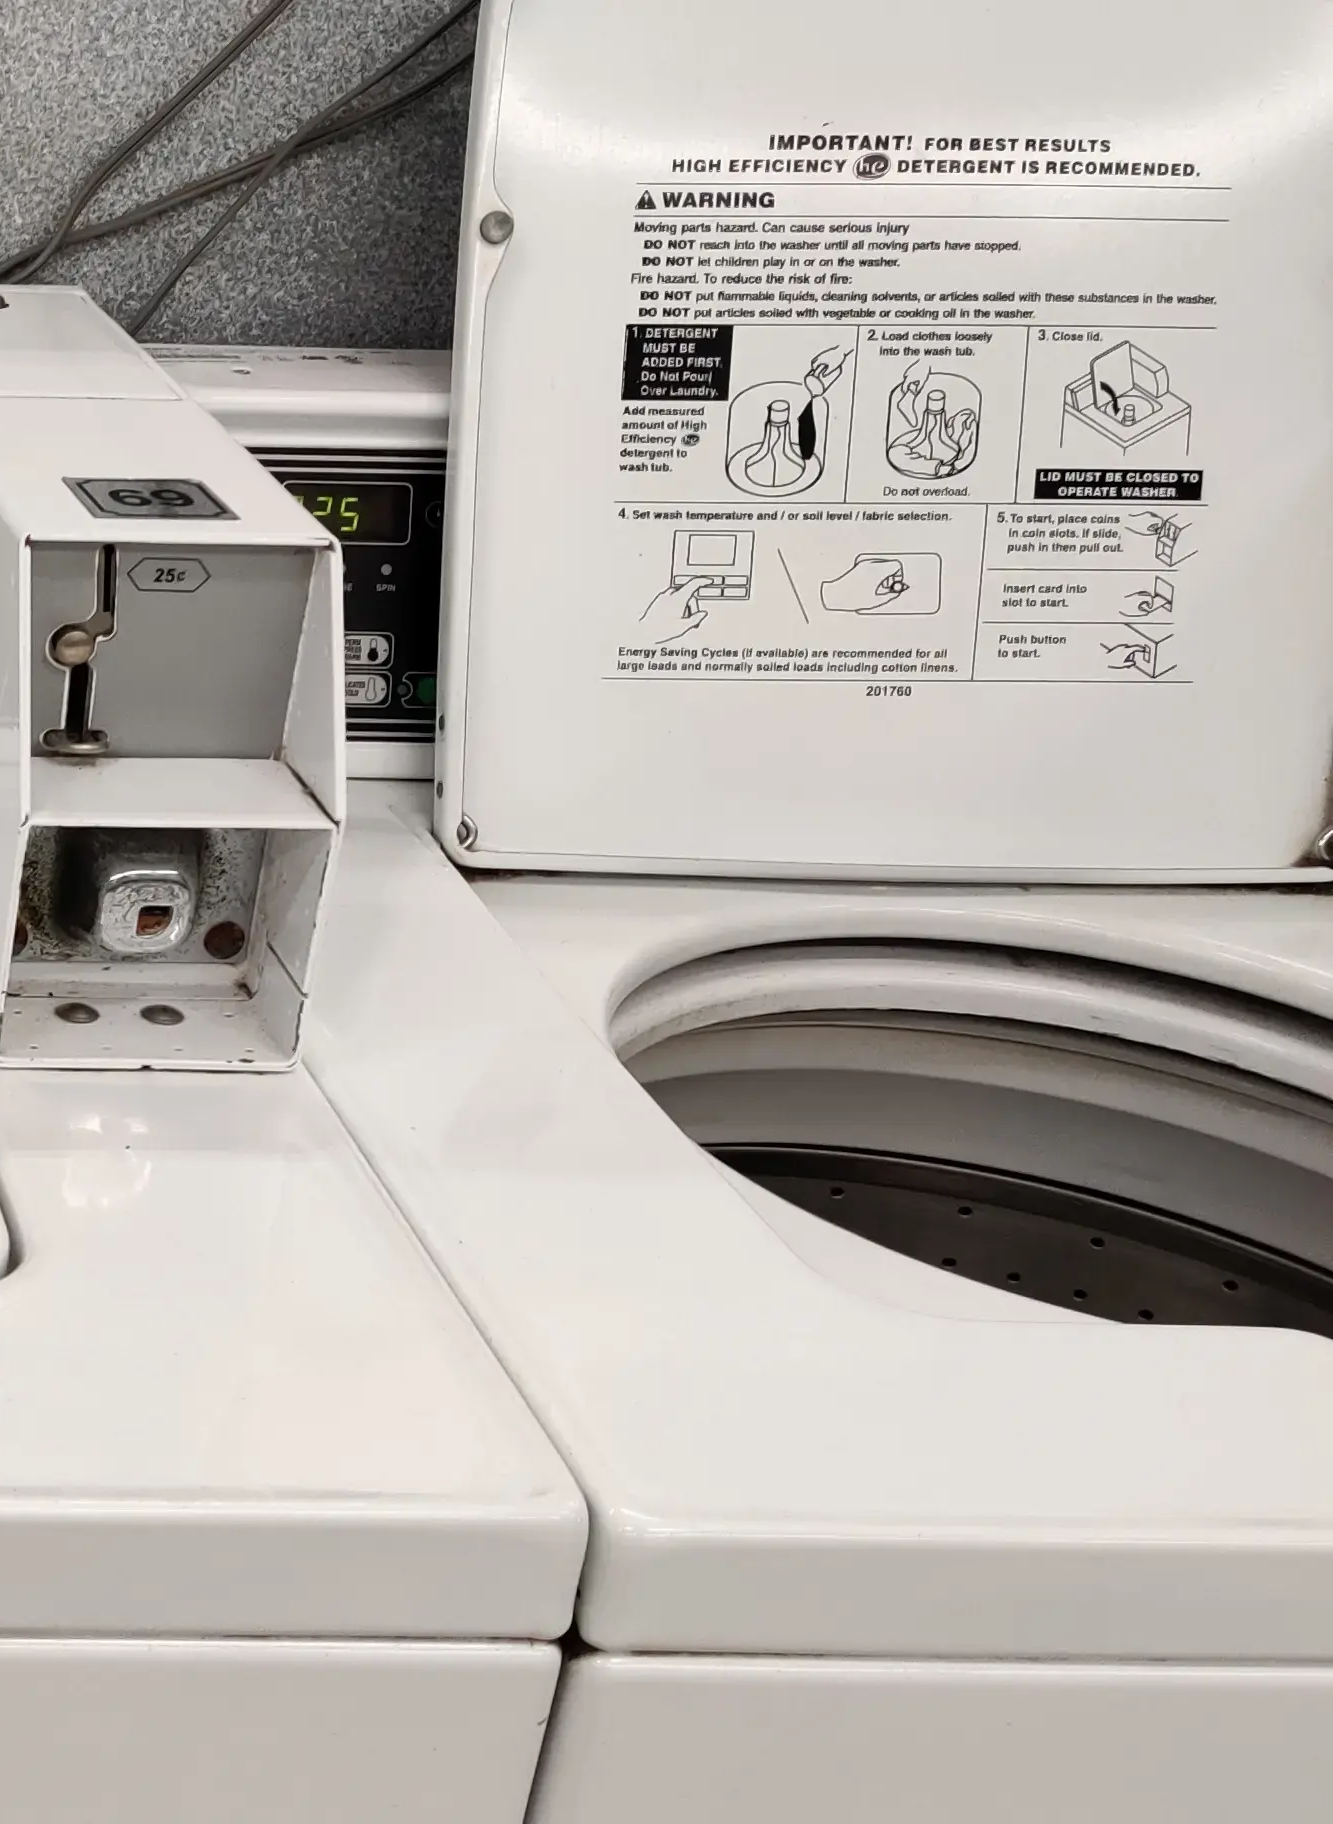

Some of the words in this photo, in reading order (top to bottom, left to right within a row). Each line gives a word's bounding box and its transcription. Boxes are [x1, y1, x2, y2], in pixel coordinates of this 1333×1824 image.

[768, 134, 912, 151] IMPORTANT!
[924, 137, 962, 151] FOR
[968, 137, 1019, 151] BEST
[1024, 138, 1110, 152] RESULTS
[671, 159, 721, 172] HIGH
[728, 159, 847, 173] EFFICIENCY
[855, 155, 888, 178] he
[897, 159, 1015, 173] DETERGENT
[1021, 160, 1039, 174] IS
[1045, 161, 1200, 176] RECOMMENDED.
[662, 191, 774, 208] WARNING
[630, 272, 653, 284] Fire
[703, 272, 717, 284] To
[721, 273, 762, 284] reduce
[765, 272, 784, 284] the
[788, 272, 810, 284] risk
[813, 272, 826, 284] of
[639, 290, 659, 301] DO
[663, 290, 692, 301] NOT
[695, 291, 714, 304] put
[820, 291, 868, 304] cleaning
[923, 293, 936, 302] or
[938, 291, 979, 301] articles
[982, 291, 1015, 302] soiled
[1018, 292, 1041, 302] with
[1044, 292, 1074, 302] these
[1077, 292, 1139, 303] substances
[1142, 293, 1152, 303] in
[1156, 293, 1173, 304] the
[881, 331, 909, 341] Load
[912, 331, 951, 341] clothes
[954, 331, 993, 343] loosely
[902, 346, 920, 356] the
[923, 346, 952, 356] wash
[1039, 471, 1061, 482] LID
[1064, 471, 1102, 482] MUST
[1105, 472, 1123, 482] BE
[1125, 472, 1178, 483] CLOSED
[1180, 472, 1199, 483] TO
[108, 489, 195, 506] 69
[1057, 486, 1117, 497] OPERATE
[292, 496, 359, 532] 25
[1009, 513, 1023, 523] To
[1057, 513, 1087, 525] place
[1090, 514, 1120, 524] coins
[1008, 527, 1018, 538] in
[1021, 528, 1045, 538] coin
[1006, 542, 1035, 554] push
[1038, 542, 1048, 552] in
[1051, 542, 1076, 552] then
[1078, 542, 1100, 554] pull
[153, 568, 188, 583] 25¢
[376, 583, 396, 592] SPIN
[865, 685, 911, 696] 201760
